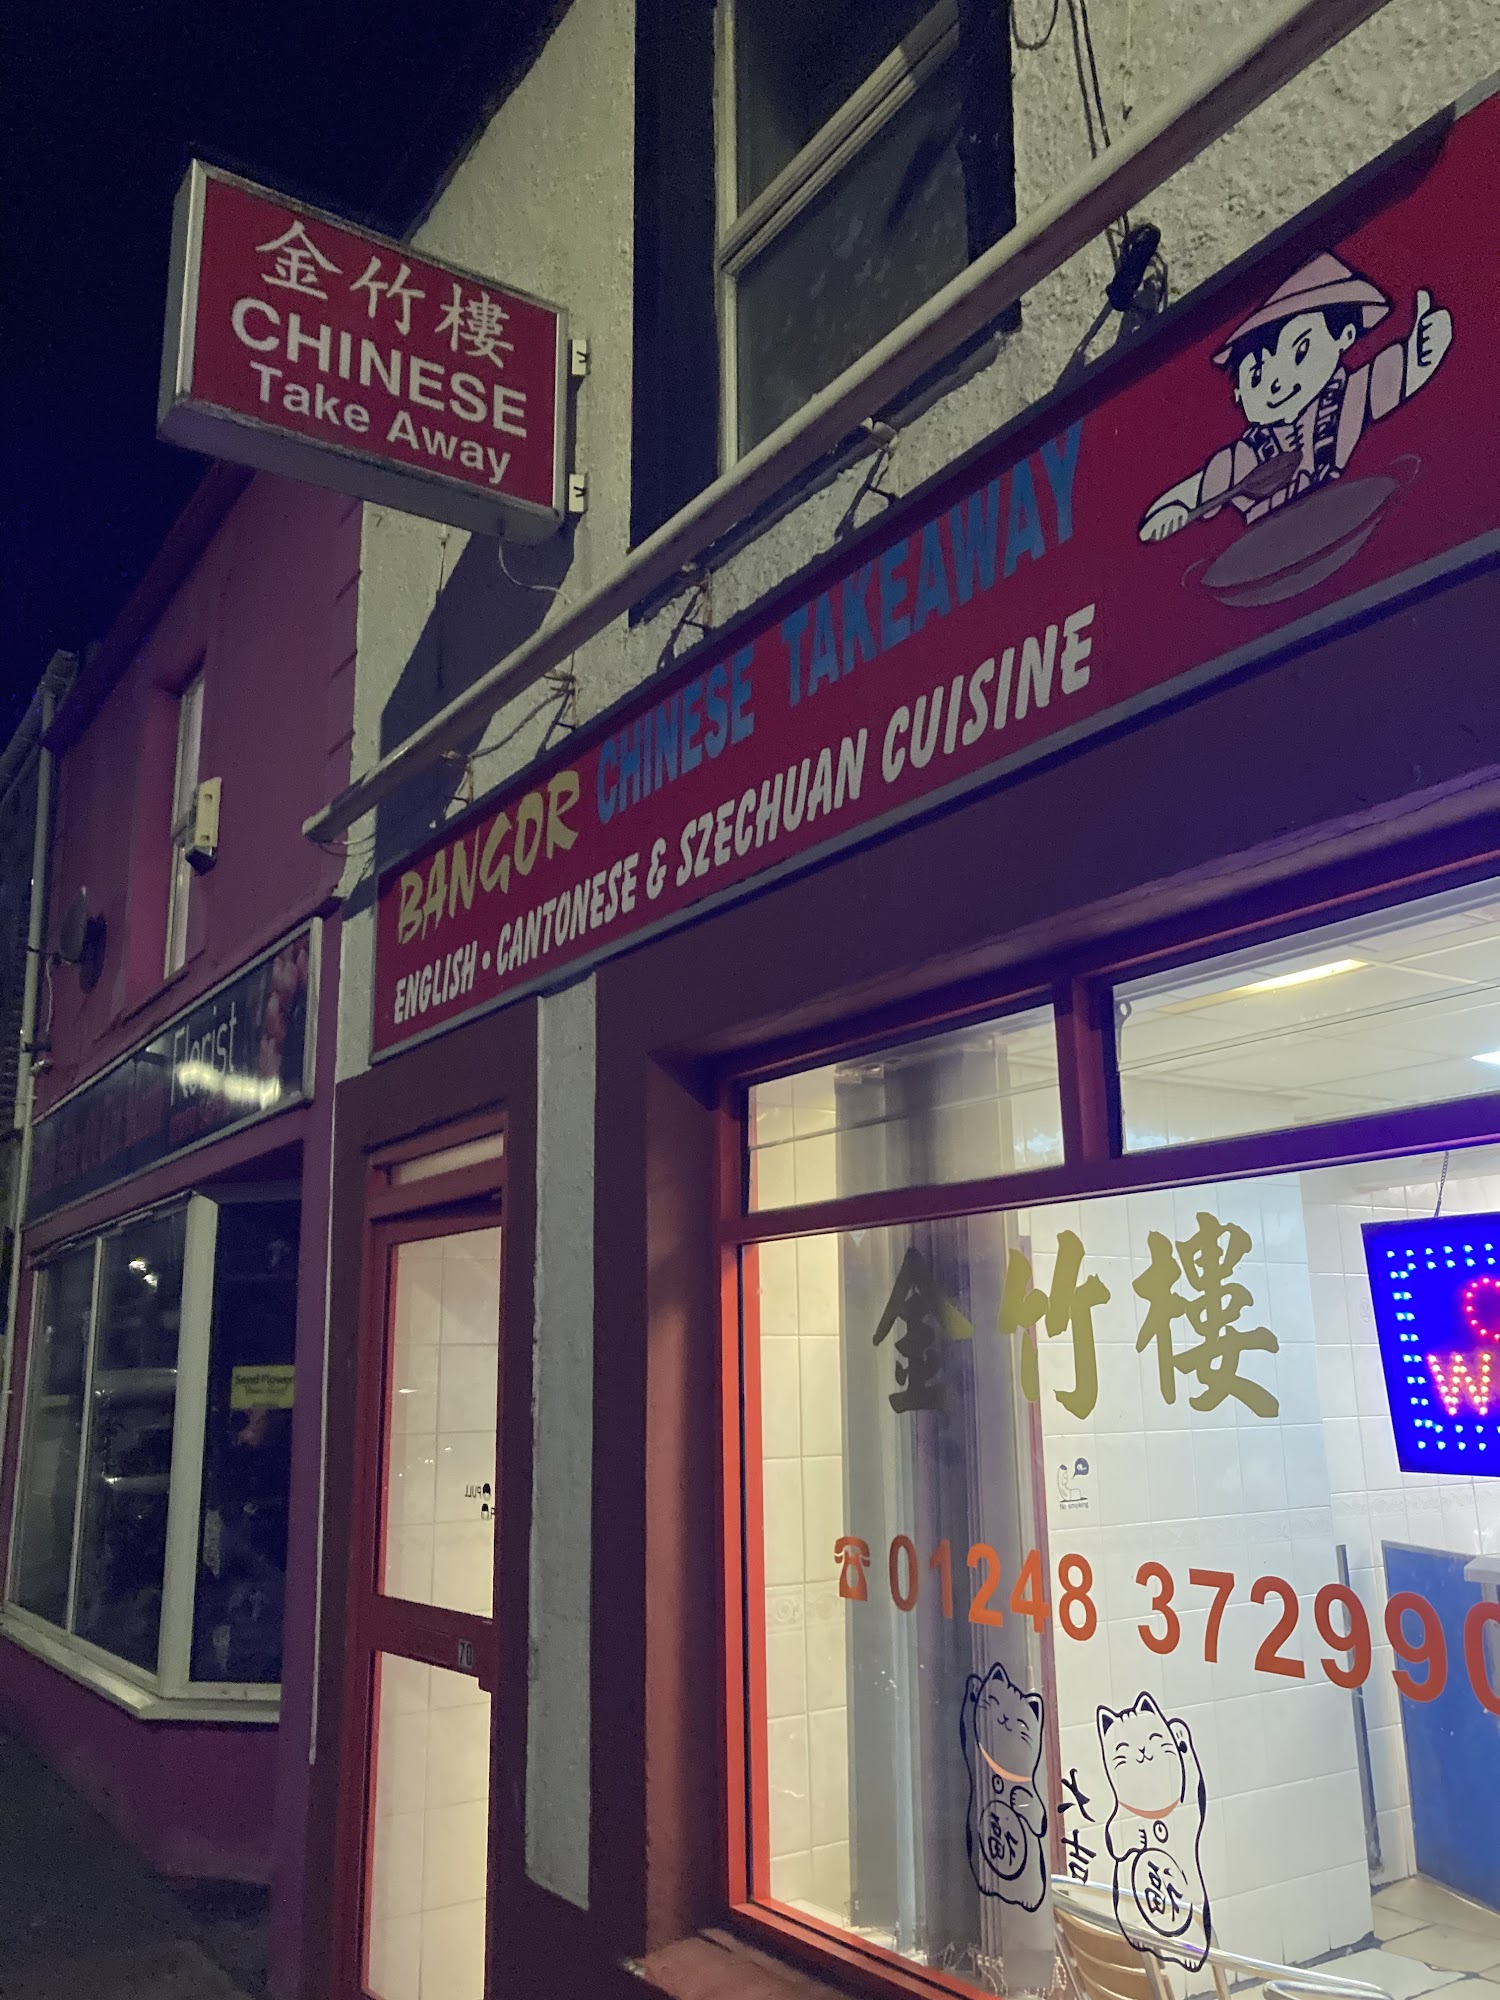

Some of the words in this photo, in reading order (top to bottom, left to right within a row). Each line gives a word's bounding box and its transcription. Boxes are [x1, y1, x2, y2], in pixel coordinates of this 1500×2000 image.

[255, 220, 514, 369] 金竹樓
[231, 297, 527, 438] CHINESE
[250, 361, 371, 433] Take
[386, 411, 512, 485] Away
[398, 770, 580, 945] BANGOR
[595, 644, 755, 824] CHINESE
[780, 420, 1084, 707] TAKEAWAY
[394, 940, 478, 1024] ENGLISH
[497, 852, 639, 976] CANTONESE
[646, 837, 667, 900] &
[676, 727, 868, 887] SZECHUAN
[881, 603, 1096, 783] CUISINE
[170, 1001, 237, 1106] Florist
[873, 1212, 1280, 1420] 金竹樓
[459, 1642, 473, 1666] 70
[889, 1533, 1098, 1642] 01248
